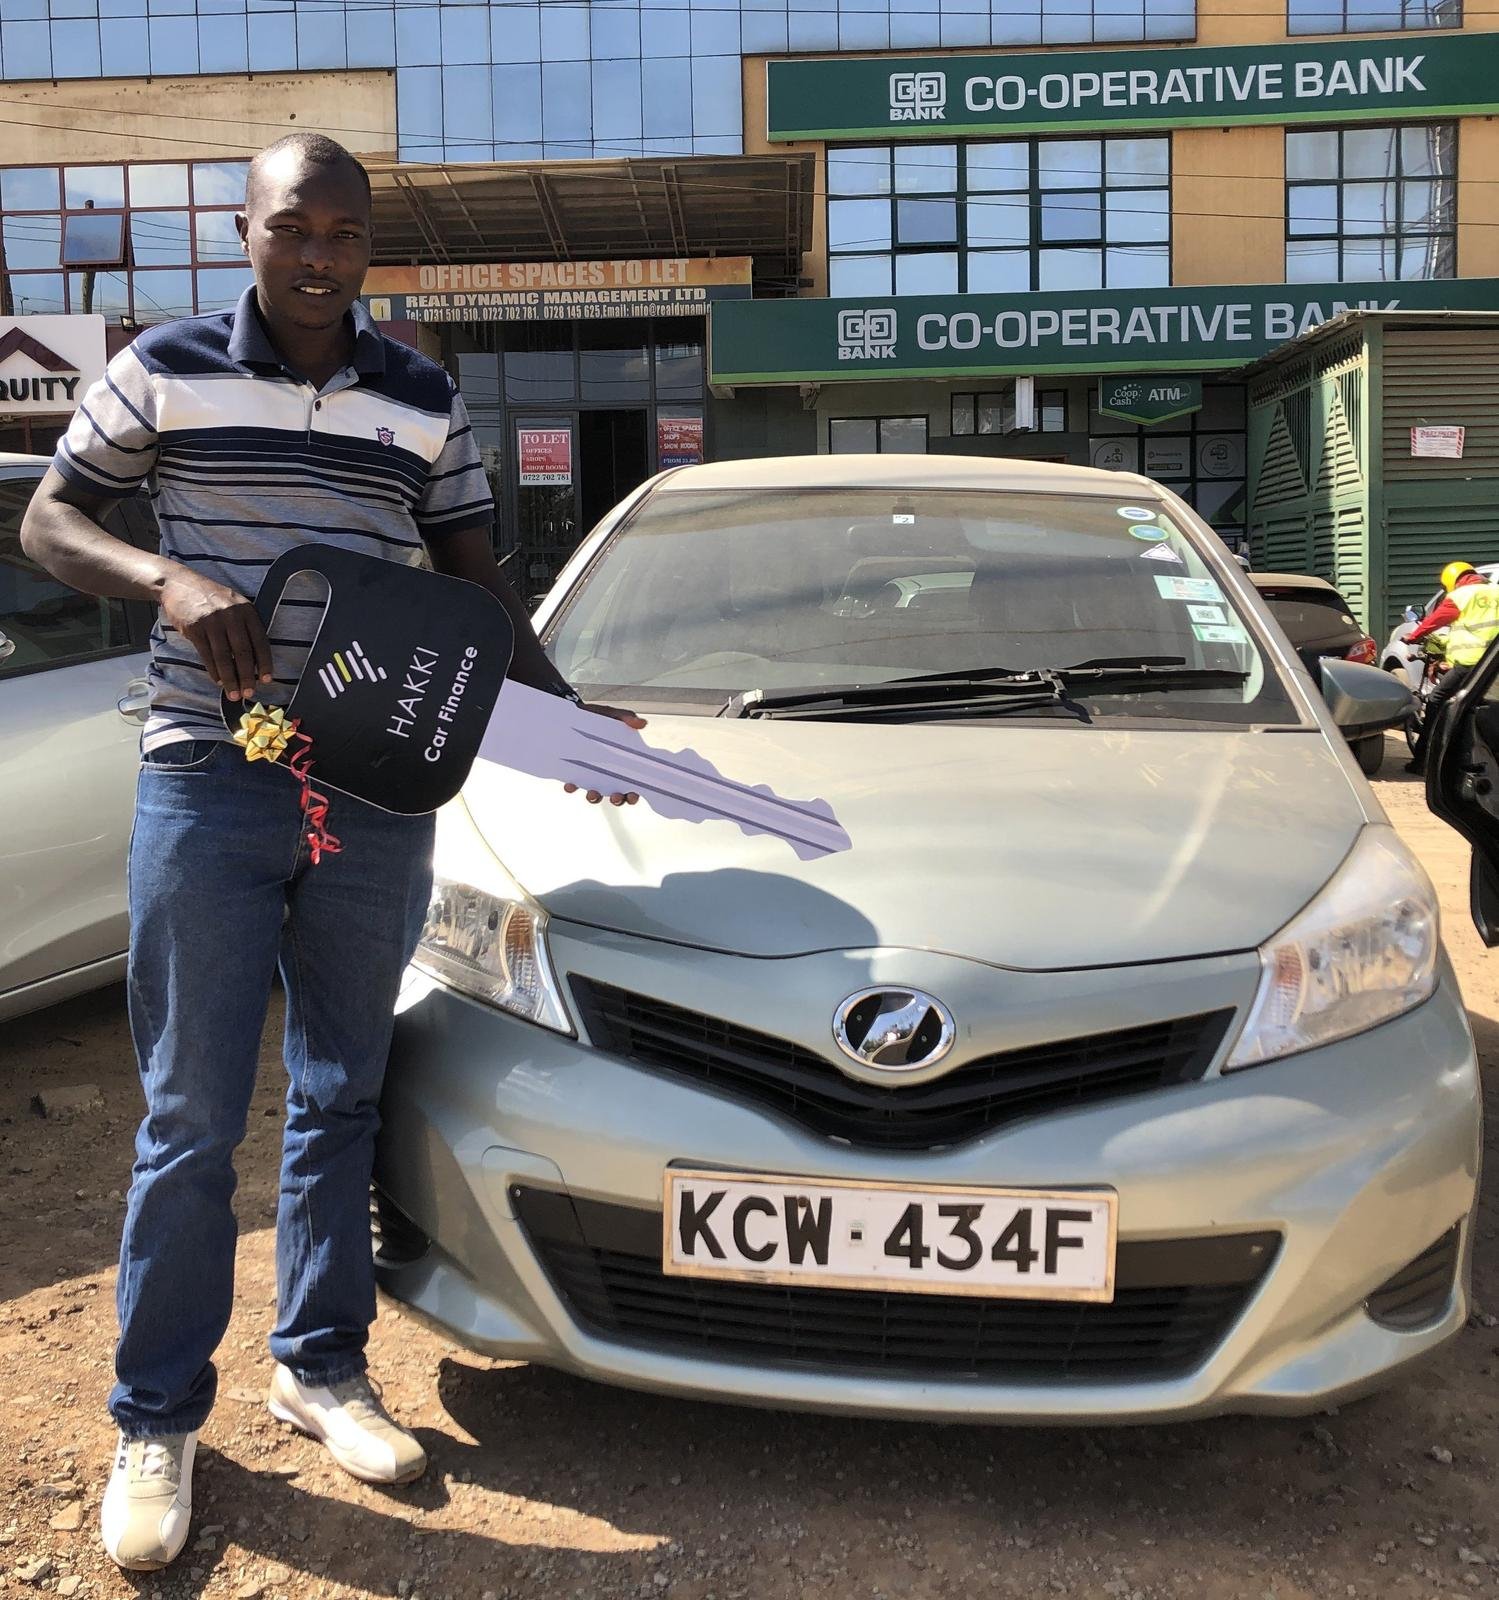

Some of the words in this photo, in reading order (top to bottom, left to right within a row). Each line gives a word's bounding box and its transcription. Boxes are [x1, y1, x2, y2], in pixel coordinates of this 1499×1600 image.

[964, 63, 1284, 112] CO-OPERATIVE
[1295, 55, 1427, 98] BANK
[889, 106, 946, 121] BANK
[419, 264, 504, 290] OFFICE
[508, 261, 605, 288] SPACES
[611, 260, 643, 285] TO
[649, 258, 689, 283] LET
[405, 295, 450, 308] REAL
[453, 292, 539, 307] DYNAMIC
[543, 289, 671, 305] MANAGEMENT
[675, 288, 707, 301] LTD
[405, 309, 422, 321] Tel:
[423, 308, 443, 321] 0731
[445, 308, 461, 321] 510
[482, 306, 503, 320] 0722
[505, 306, 521, 320] 702
[543, 304, 564, 319] 0728
[566, 304, 581, 319] 145
[916, 303, 1252, 351] CO-OPERATIVE
[837, 345, 897, 360] BANK
[1109, 397, 1132, 406] Cash
[1114, 388, 1138, 398] Coop
[1148, 387, 1181, 401] ATM
[522, 434, 540, 444] TO
[542, 434, 568, 444] LET
[386, 646, 440, 738] HAKKI
[424, 726, 449, 762] Car
[437, 645, 478, 723] Finance
[678, 1189, 833, 1266] KCW
[883, 1202, 1093, 1274] 434F
